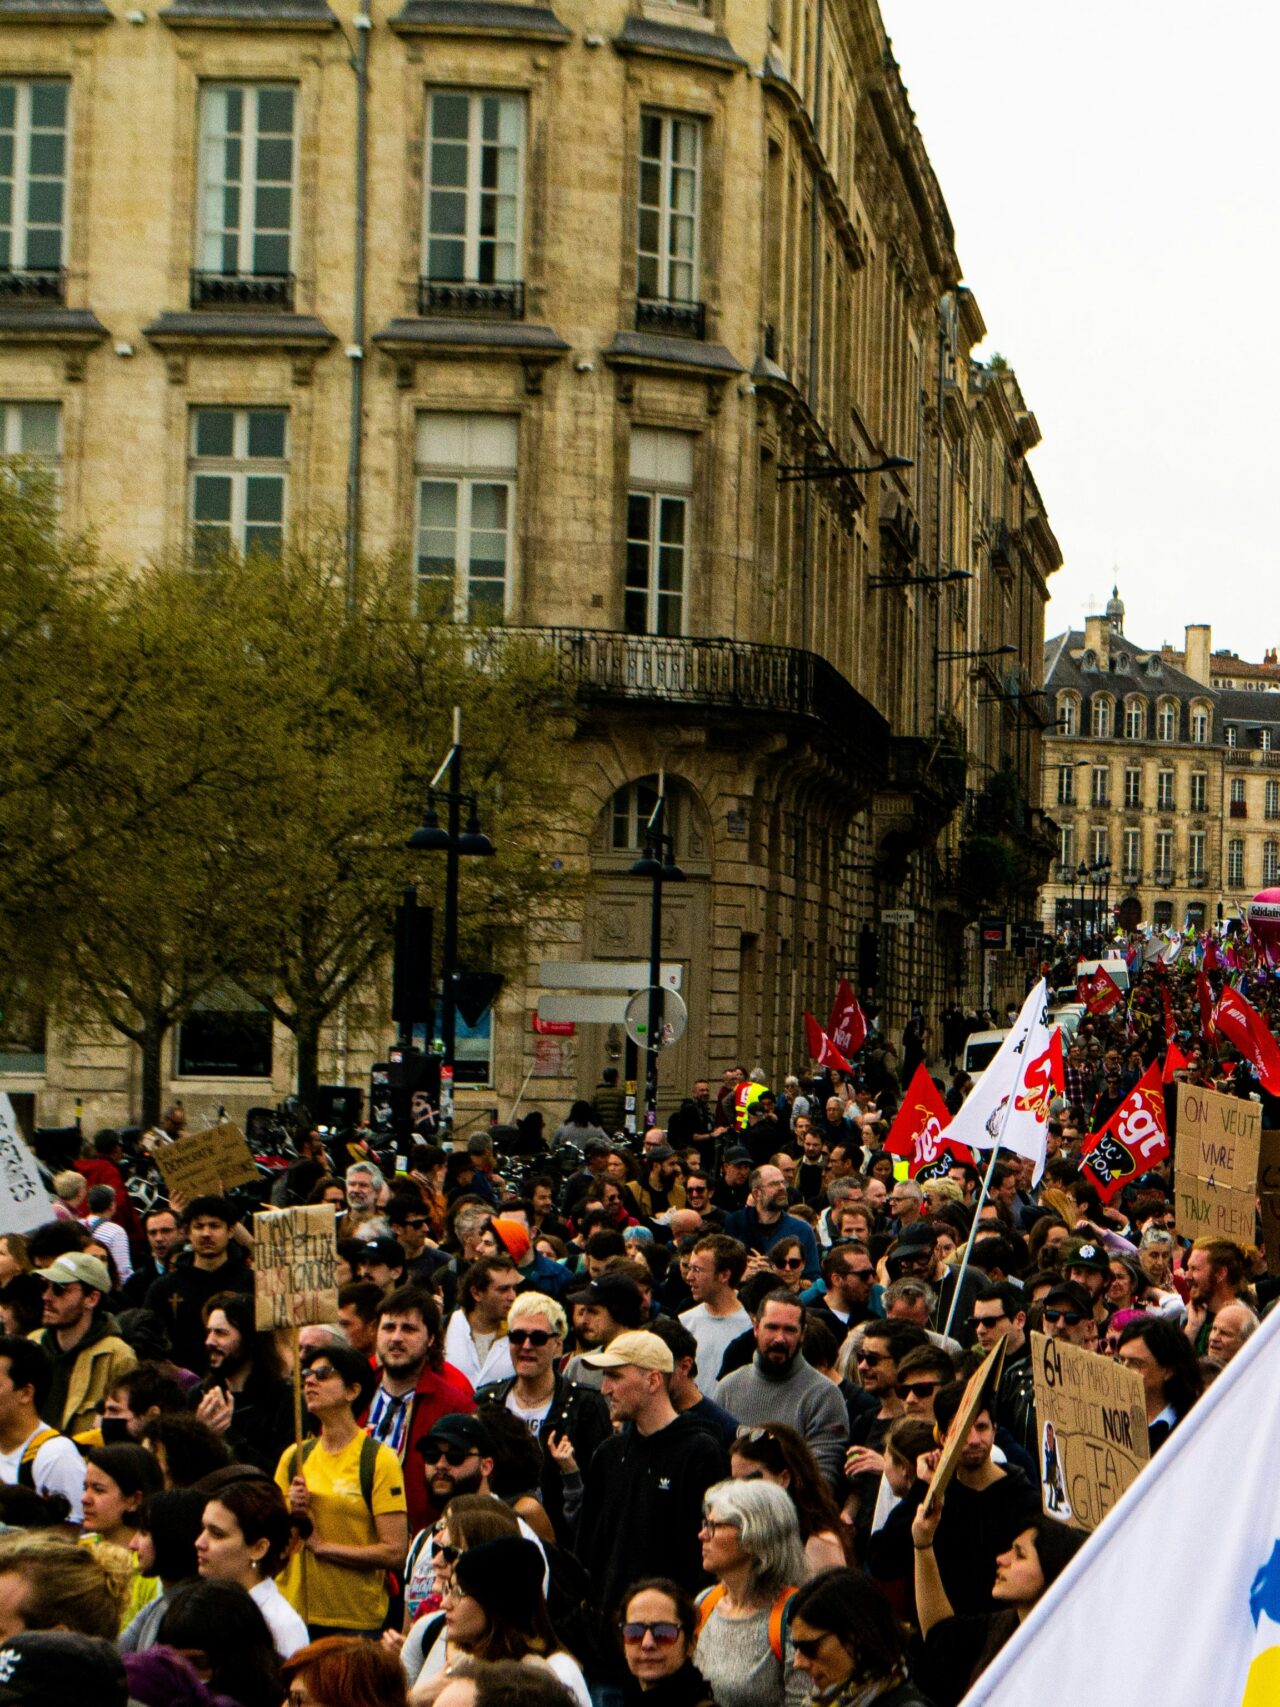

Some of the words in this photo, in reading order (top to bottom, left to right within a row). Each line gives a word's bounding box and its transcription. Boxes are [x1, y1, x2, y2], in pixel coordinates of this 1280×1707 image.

[1118, 1092, 1165, 1158] cgt
[1184, 1096, 1209, 1123] ON
[1220, 1106, 1259, 1138] VEUT
[1181, 1194, 1212, 1225] TAUX
[1217, 1204, 1252, 1236] PLEIN
[1043, 1337, 1063, 1387] 64
[1101, 1405, 1133, 1450] NOIR
[1086, 1441, 1119, 1487] TA
